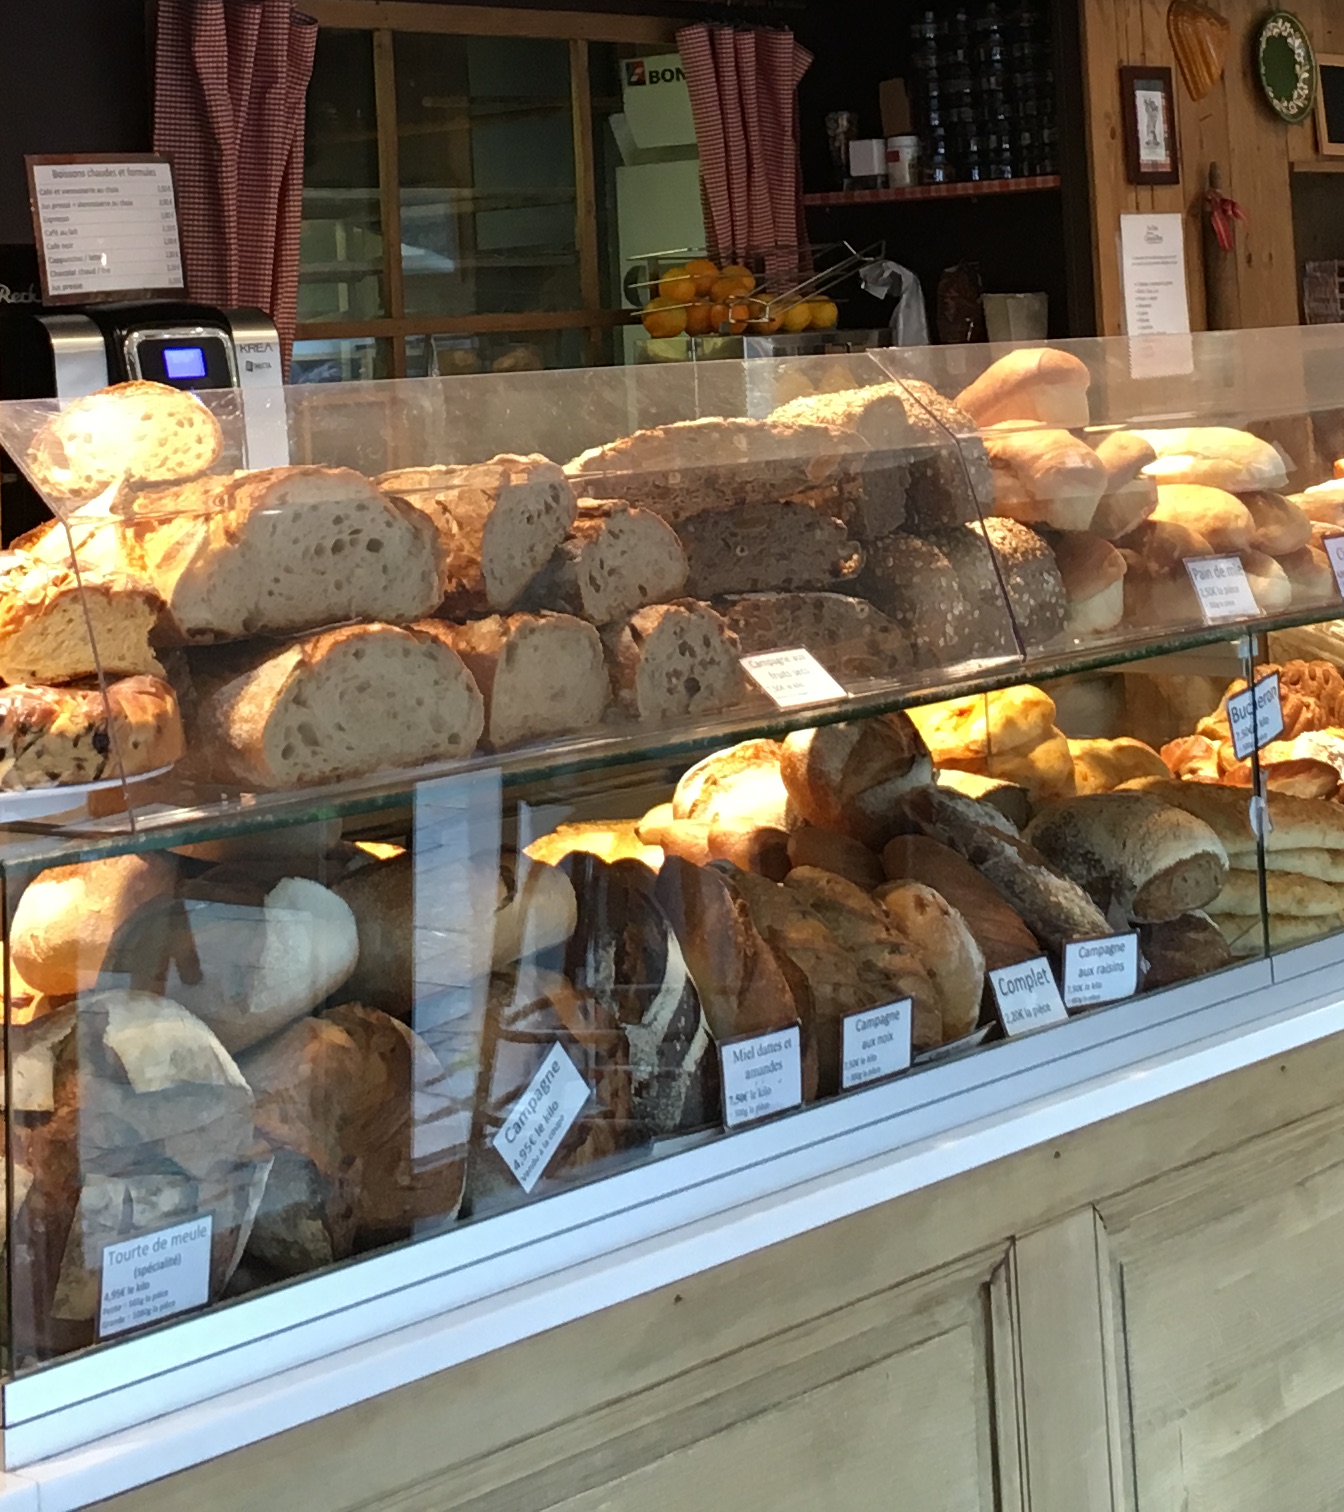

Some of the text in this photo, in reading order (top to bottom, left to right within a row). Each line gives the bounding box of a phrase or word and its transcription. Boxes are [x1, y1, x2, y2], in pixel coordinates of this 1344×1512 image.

[1191, 568, 1213, 580] Pain
[1214, 565, 1226, 578] de
[1231, 686, 1277, 724] Buceron
[1078, 943, 1126, 959] Campagne
[998, 967, 1050, 996] Complet
[1078, 962, 1125, 978] aux raisins
[855, 1010, 900, 1032] Campagne
[733, 1046, 755, 1063] Miel
[745, 1060, 783, 1080] amandes
[505, 1060, 561, 1144] Campagne
[512, 1100, 560, 1171] 4,95€ le kilo
[520, 1155, 540, 1182] Vendu
[108, 1225, 207, 1266] Tourte de meule
[134, 1253, 182, 1279] (spécialité)
[136, 1282, 150, 1292] kilo
